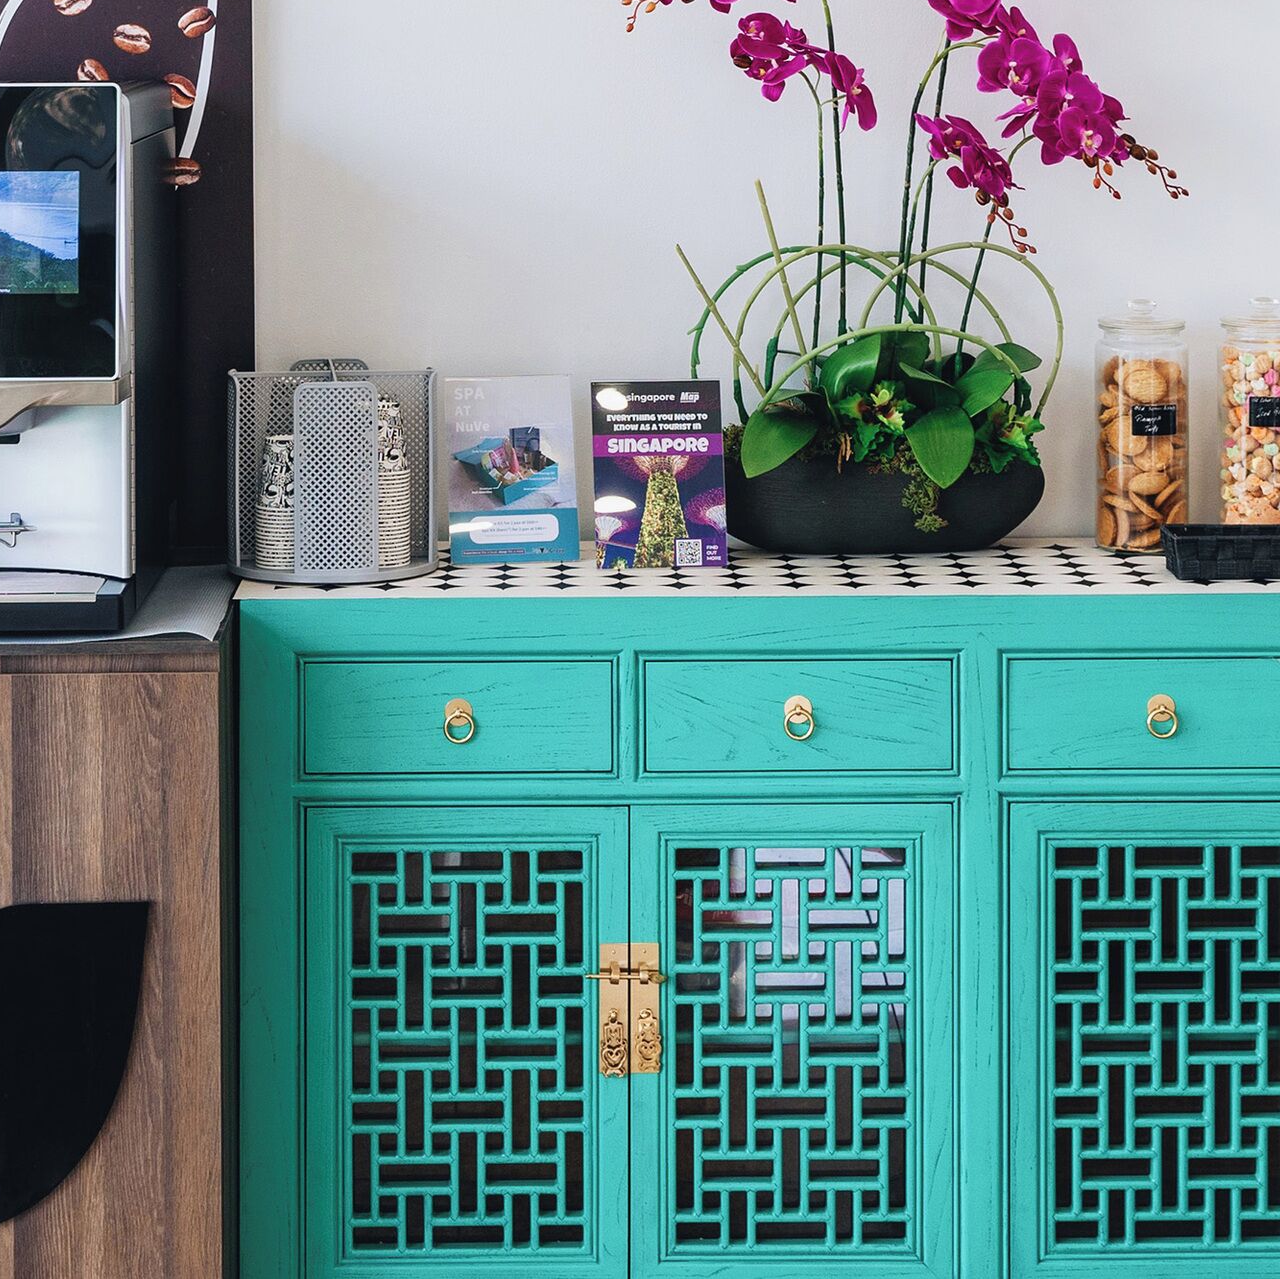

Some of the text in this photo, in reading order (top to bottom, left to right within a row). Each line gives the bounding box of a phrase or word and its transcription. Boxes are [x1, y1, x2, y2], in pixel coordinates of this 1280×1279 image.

[454, 388, 485, 400] SPA
[455, 406, 471, 417] AT
[456, 421, 490, 433] NuVe
[640, 423, 650, 431] AS
[651, 423, 658, 431] A
